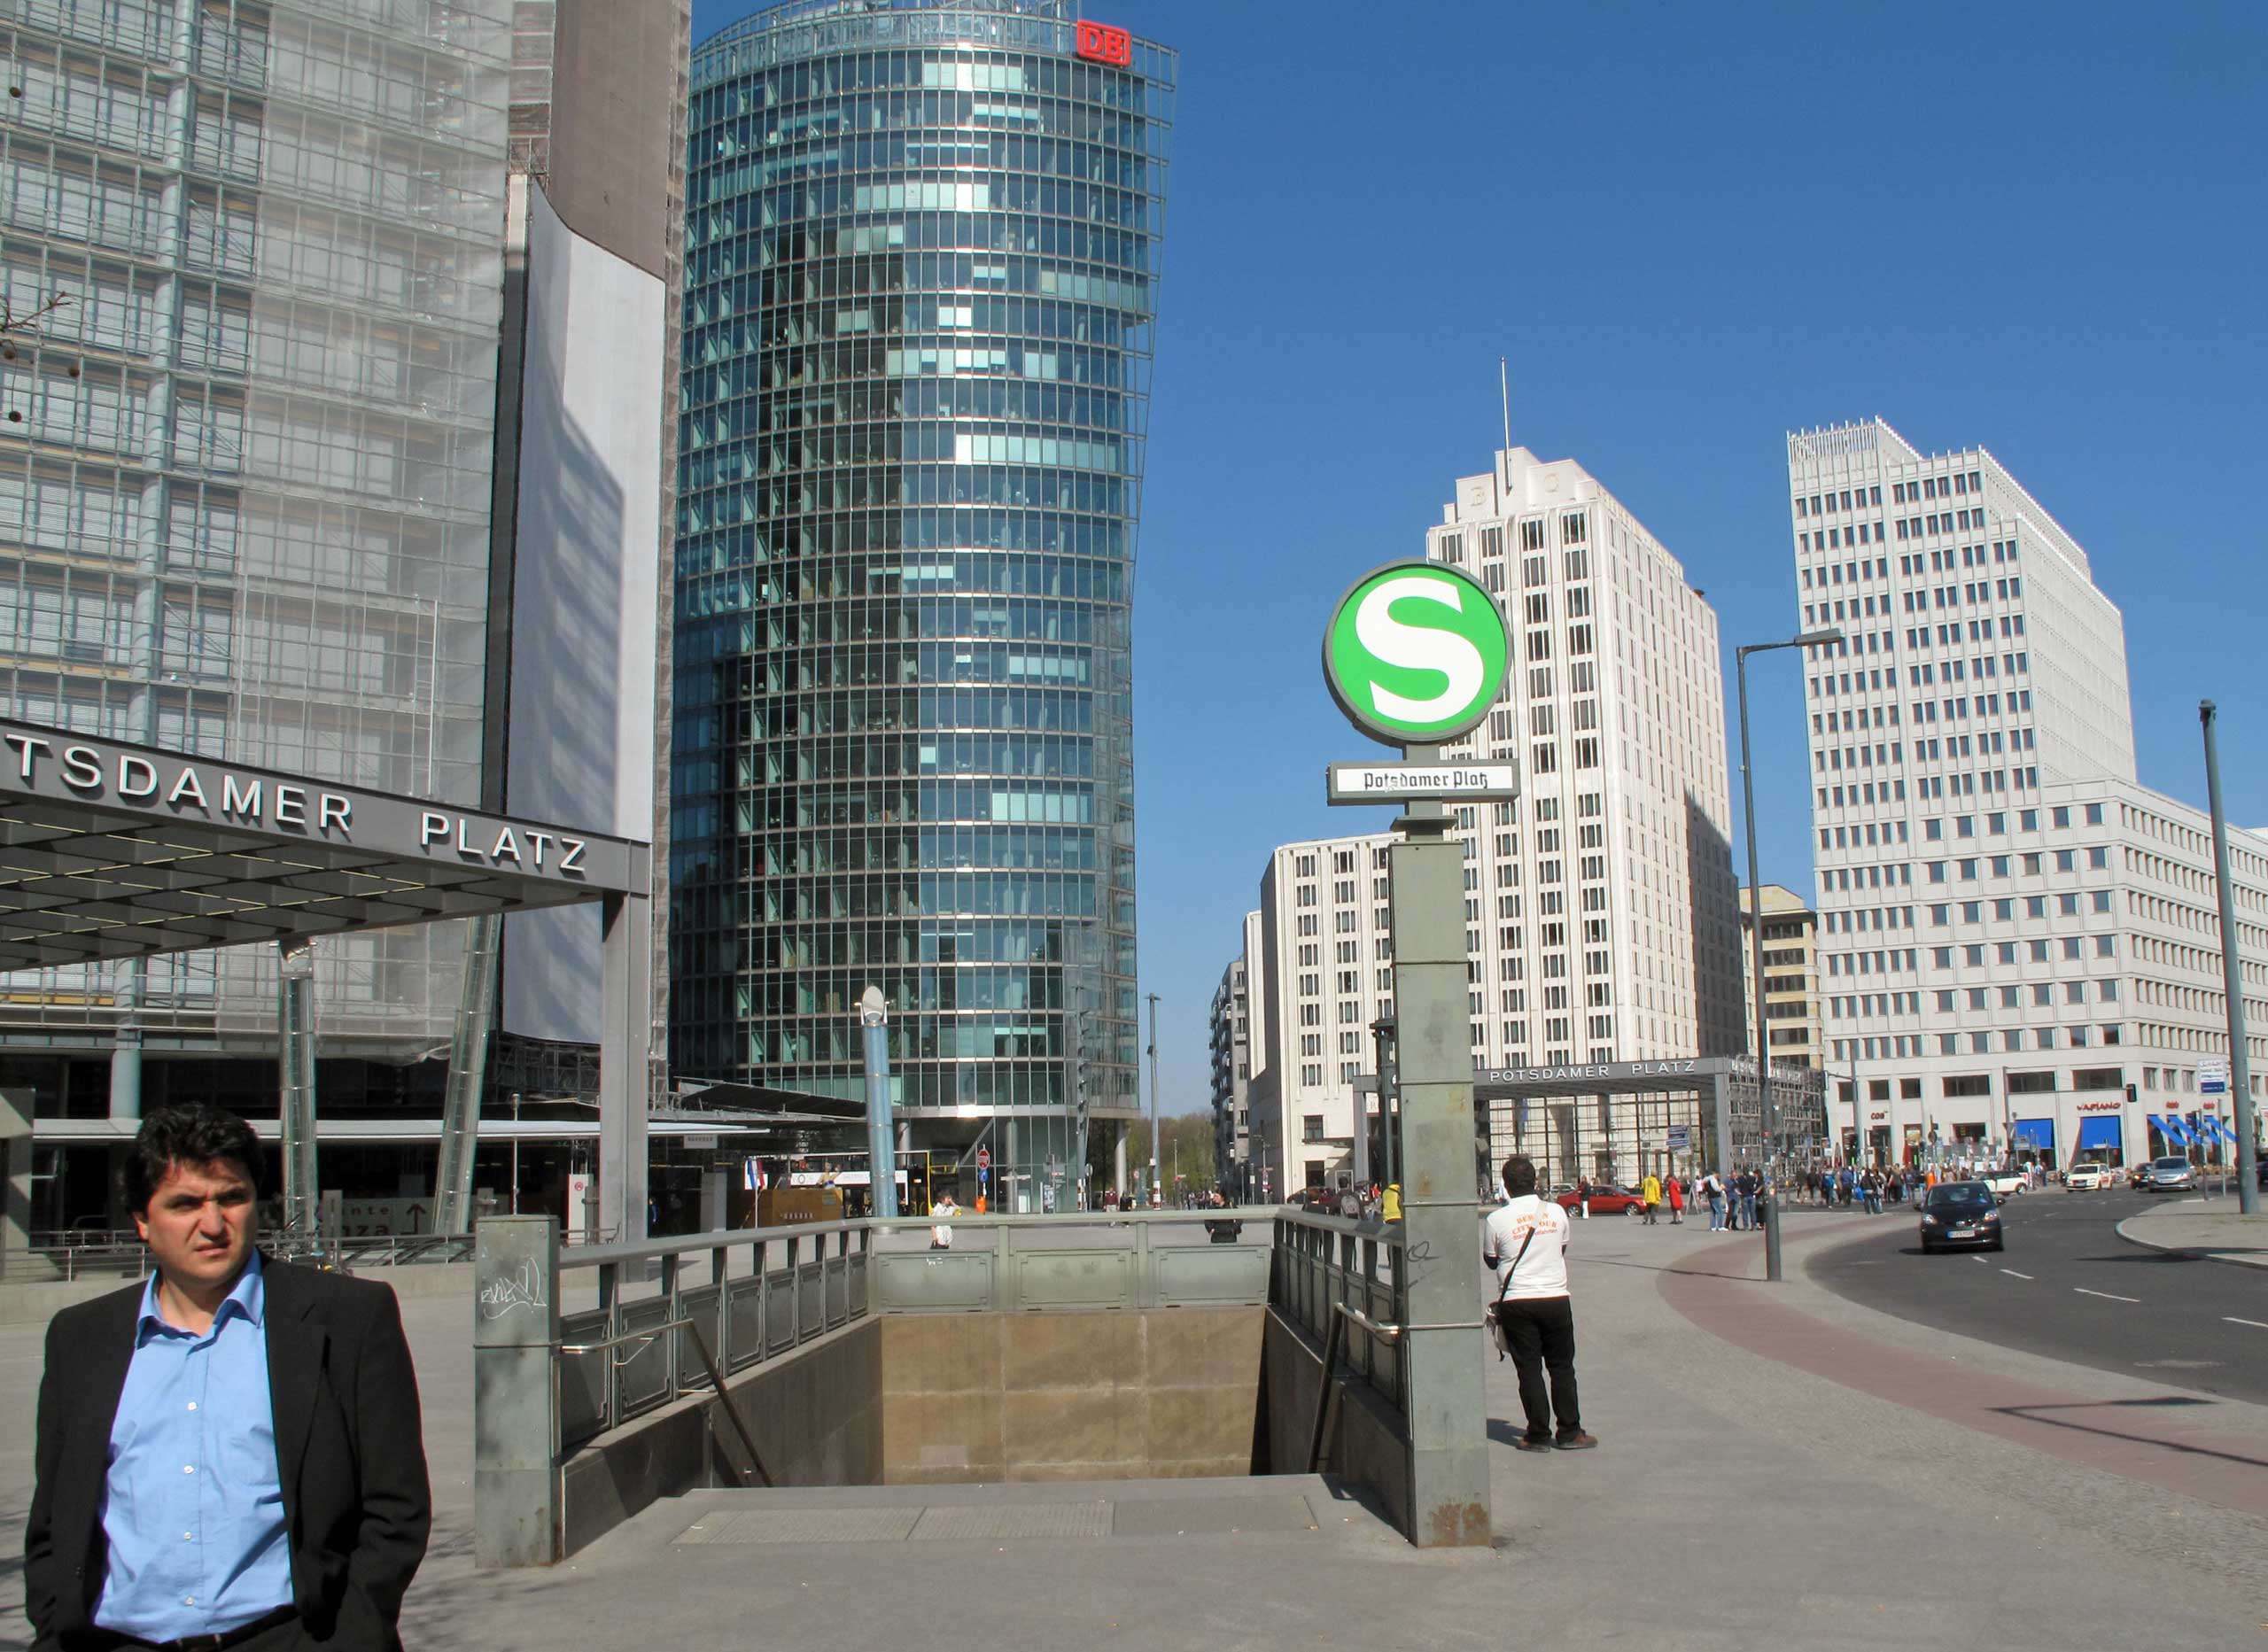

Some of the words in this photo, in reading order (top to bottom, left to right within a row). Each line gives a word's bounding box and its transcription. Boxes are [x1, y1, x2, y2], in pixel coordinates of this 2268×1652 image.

[1084, 27, 1122, 58] DB
[1355, 577, 1484, 723] S
[1363, 772, 1449, 790] Potsdamer
[1453, 770, 1488, 789] Platz
[421, 812, 586, 873] PLATZ
[1489, 1065, 1609, 1082] POTSDAMER
[1632, 1060, 1695, 1074] PLATZ
[2077, 1101, 2121, 1112] VAPIANO
[1516, 1212, 1550, 1224] BERN
[1534, 1220, 1557, 1229] OUR
